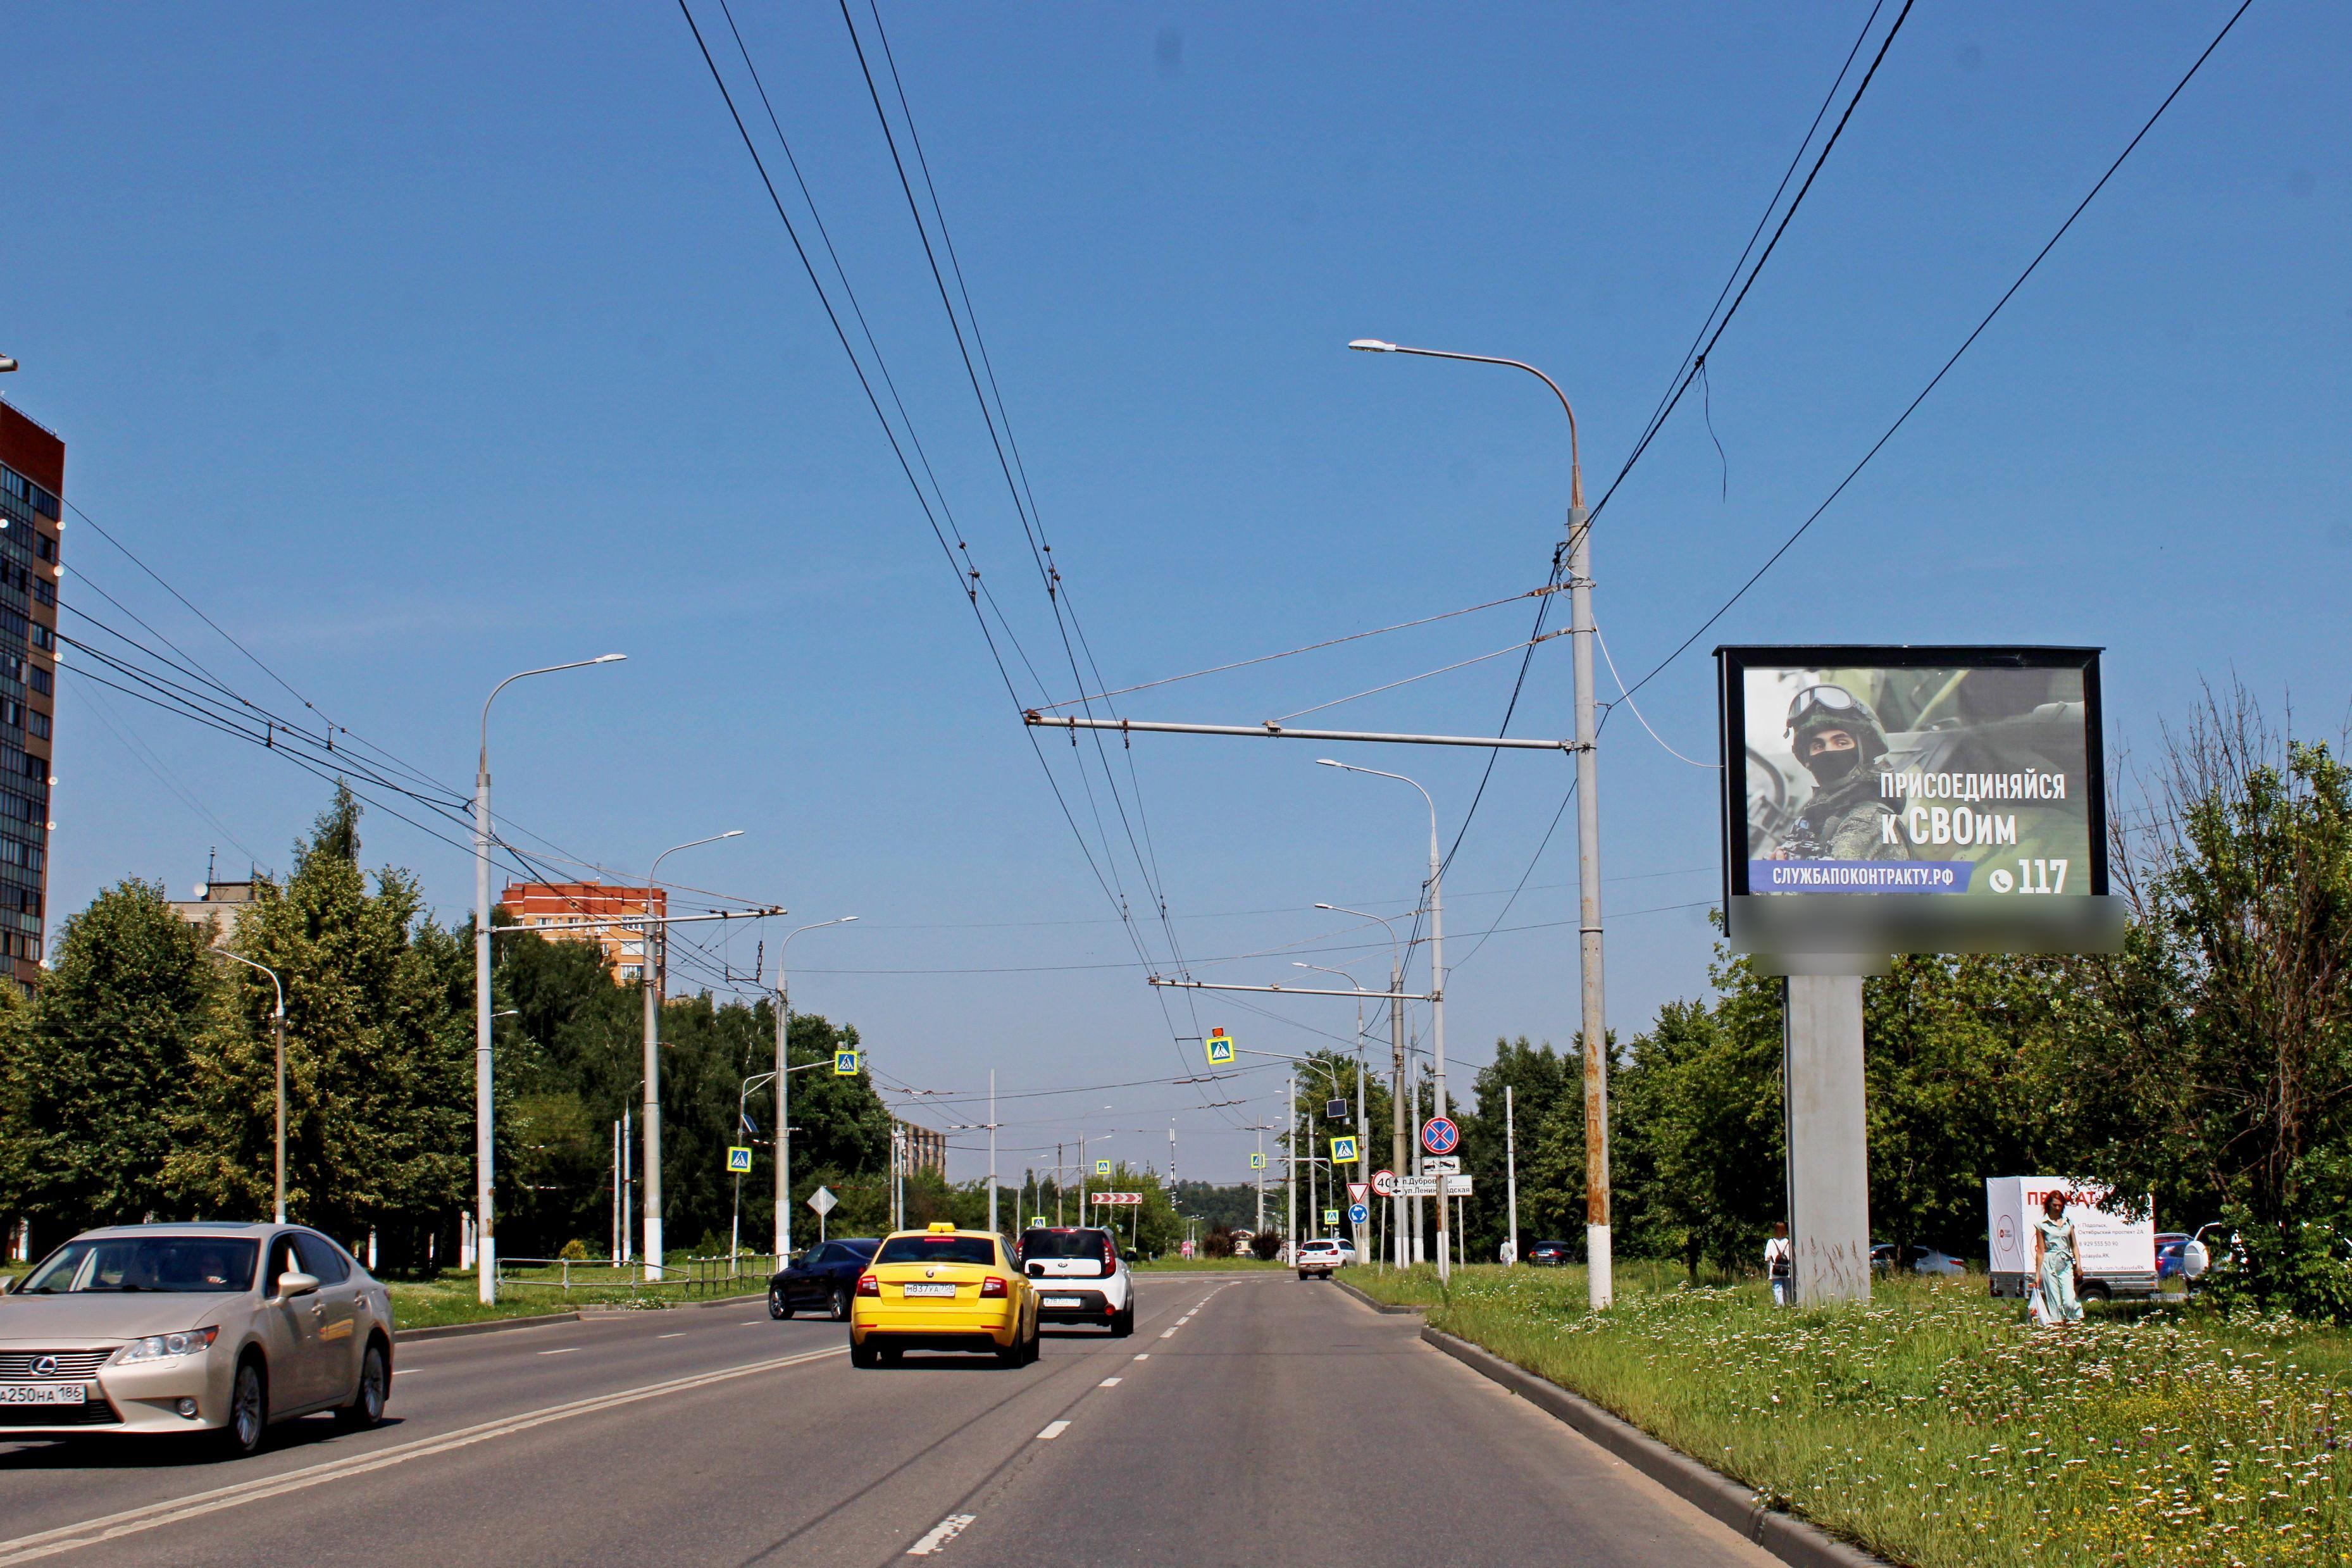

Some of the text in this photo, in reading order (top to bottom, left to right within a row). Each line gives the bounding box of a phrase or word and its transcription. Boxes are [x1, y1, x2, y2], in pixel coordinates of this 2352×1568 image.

[1881, 768, 2065, 802] ПРИСОЕДИНЯЙСЯ
[1772, 868, 1953, 885] СЛУЖБАПОКОНТРАКТУ.РФ
[2018, 859, 2068, 894] 117
[2027, 1192, 2096, 1205] ПРКАТ
[59, 1386, 82, 1397] 186
